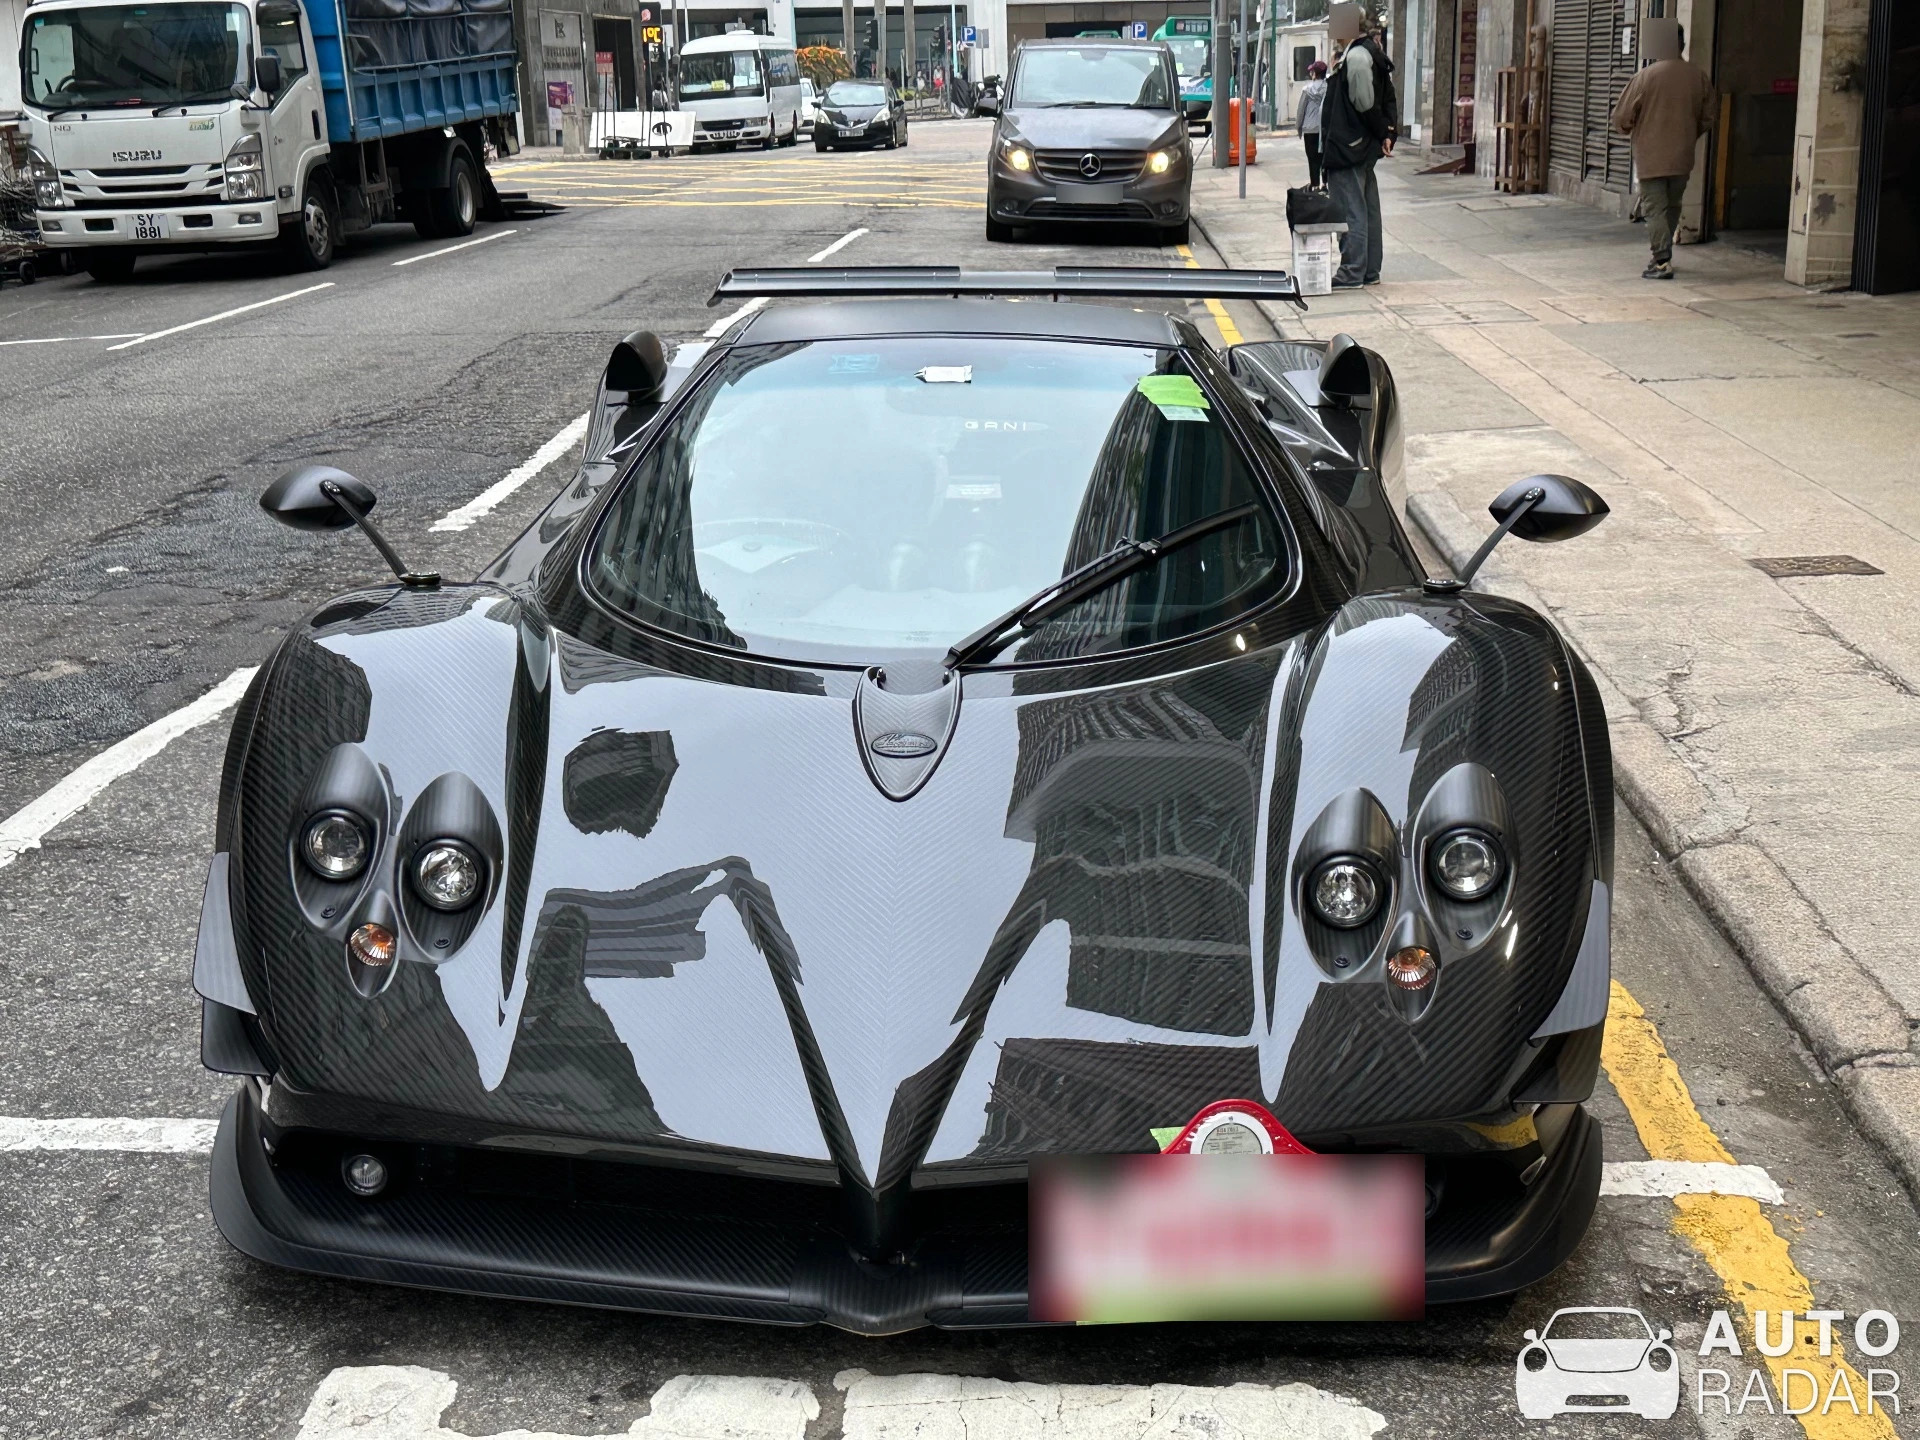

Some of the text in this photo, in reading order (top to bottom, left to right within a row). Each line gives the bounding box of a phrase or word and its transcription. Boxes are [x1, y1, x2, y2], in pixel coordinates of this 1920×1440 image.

[964, 27, 974, 41] P
[1135, 24, 1144, 38] P
[113, 150, 162, 162] ISUZU
[137, 213, 154, 226] SY
[135, 226, 161, 239] 1881
